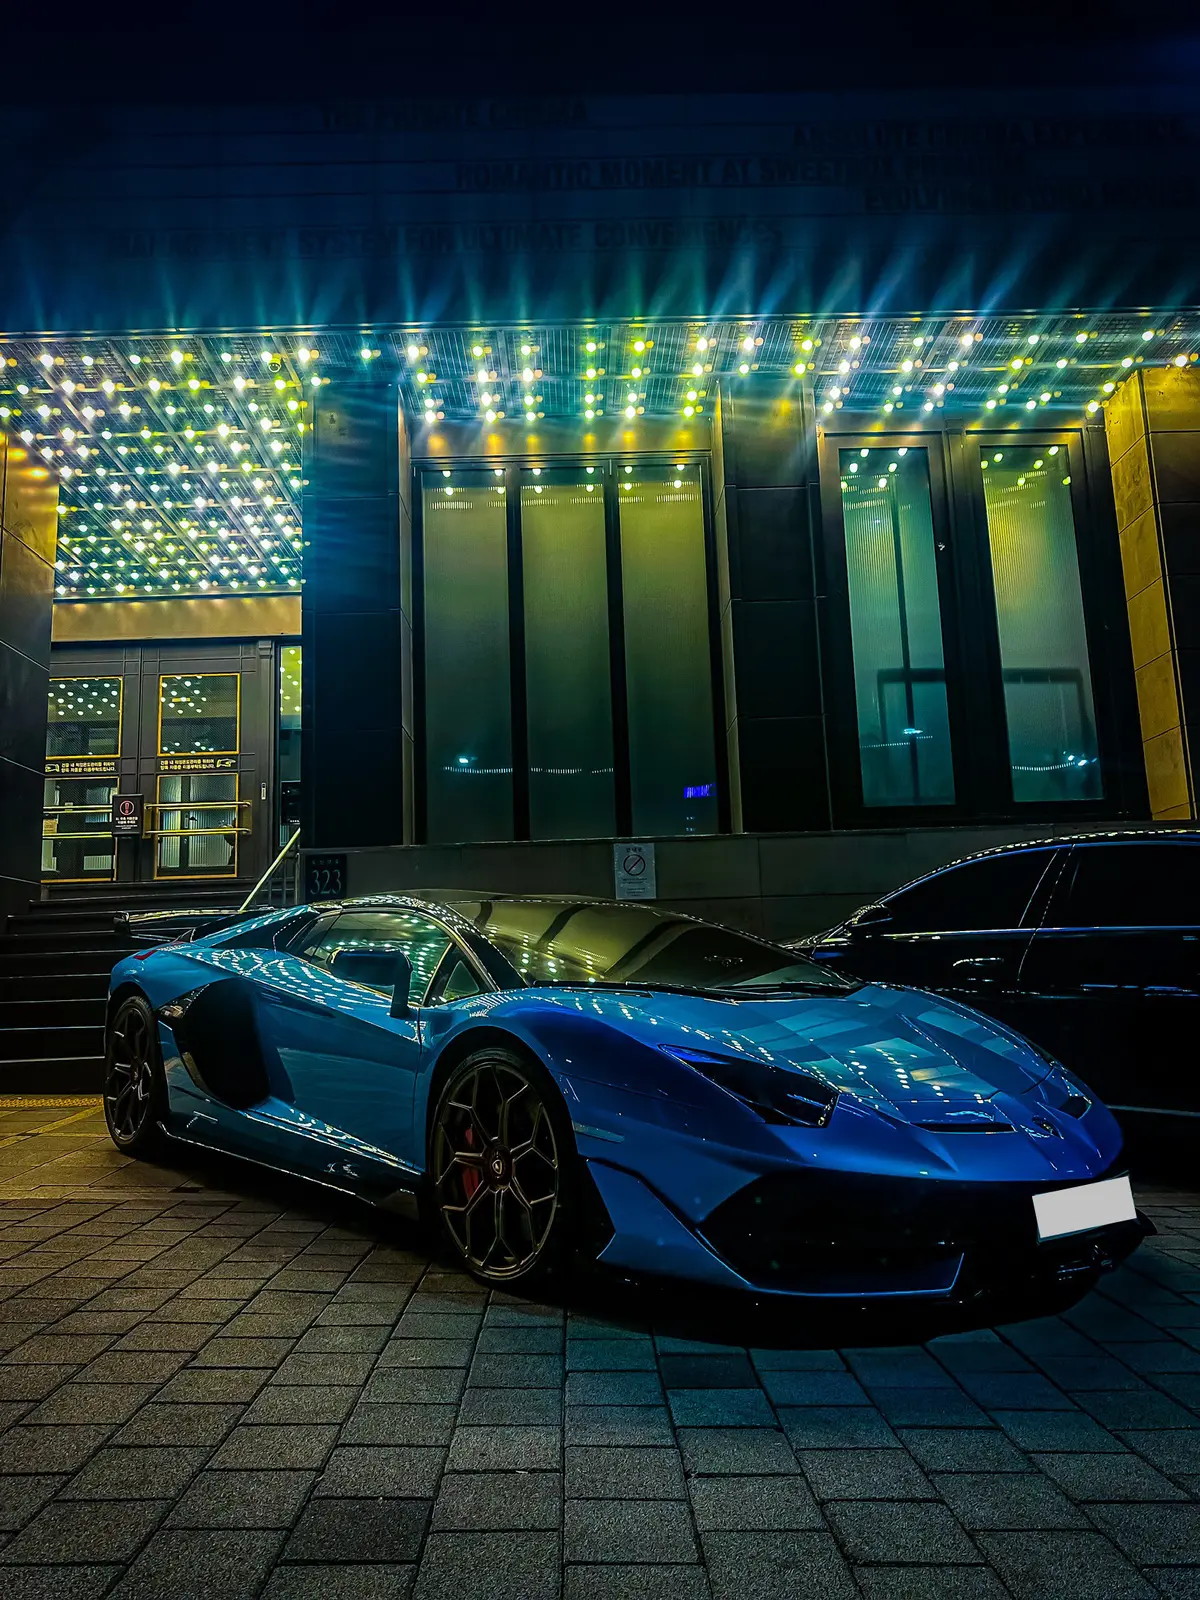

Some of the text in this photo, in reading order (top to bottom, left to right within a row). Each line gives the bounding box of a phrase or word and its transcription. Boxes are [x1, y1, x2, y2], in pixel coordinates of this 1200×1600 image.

[456, 161, 591, 189] ROMANTIC
[600, 159, 713, 186] MOMENT
[722, 157, 752, 185] AT
[298, 227, 391, 257] SYSTEM
[407, 226, 452, 254] FOR
[461, 223, 581, 251] ULTIMATE
[310, 869, 342, 895] 323
